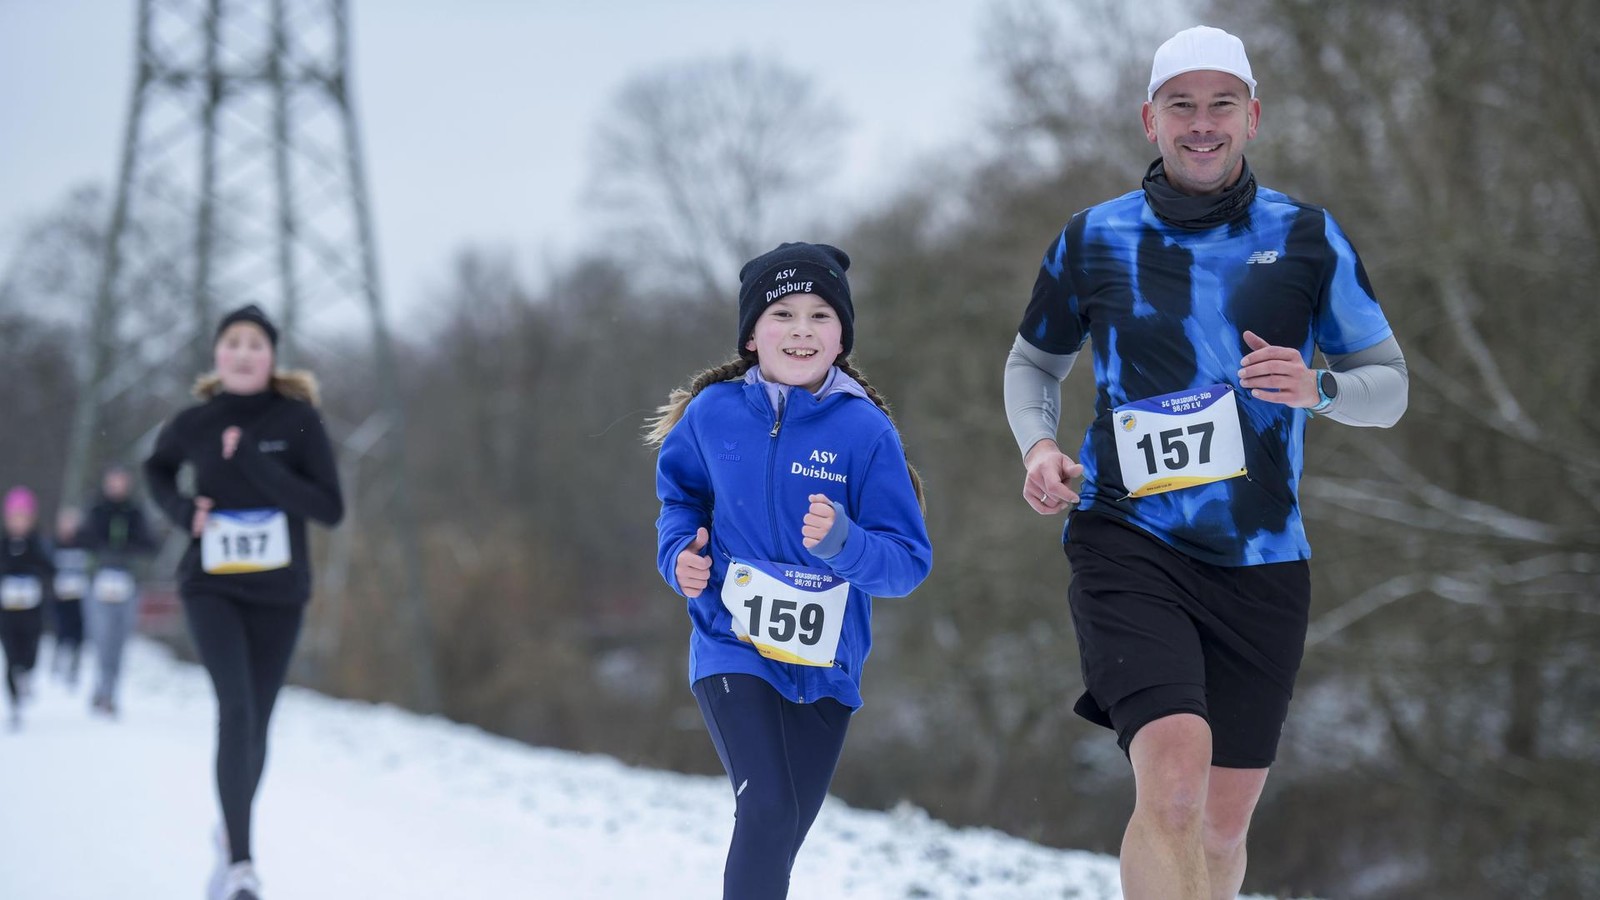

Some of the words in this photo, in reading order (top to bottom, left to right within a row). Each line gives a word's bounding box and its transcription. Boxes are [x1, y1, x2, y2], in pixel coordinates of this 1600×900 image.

[775, 268, 797, 281] ASV
[766, 281, 813, 302] Duisburg
[1161, 400, 1170, 408] SG
[1172, 403, 1191, 412] 98/20
[1136, 421, 1215, 475] 157
[809, 450, 838, 464] ASV
[794, 578, 812, 587] 98/20
[743, 595, 825, 646] 159
